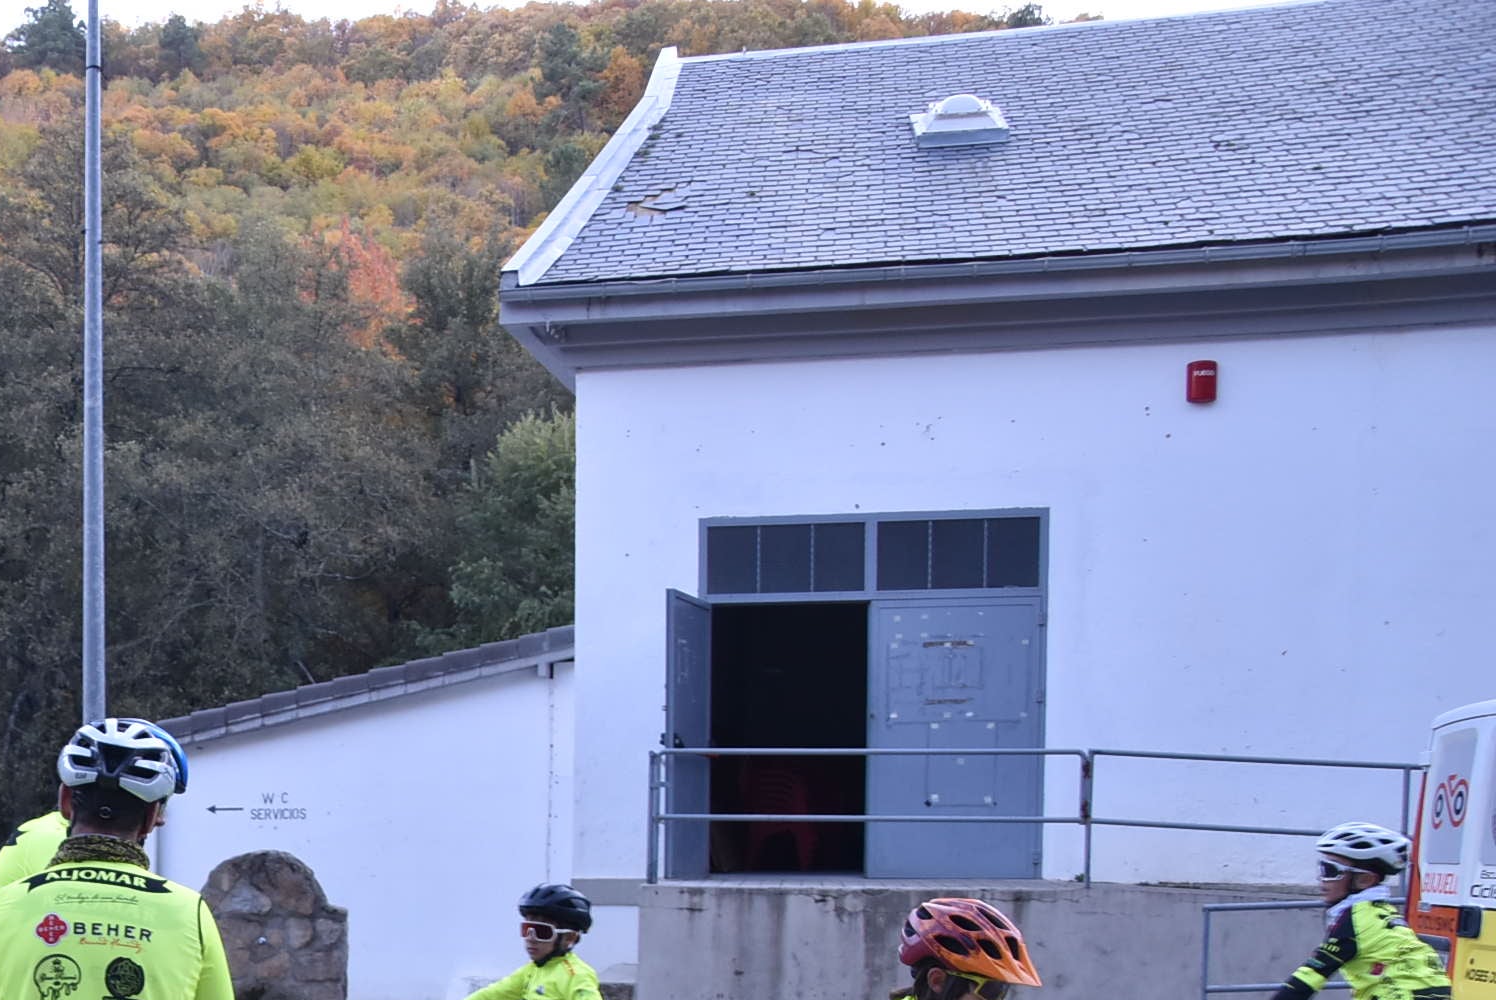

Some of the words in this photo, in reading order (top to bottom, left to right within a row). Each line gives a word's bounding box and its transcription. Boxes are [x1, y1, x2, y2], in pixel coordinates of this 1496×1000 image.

[261, 792, 275, 804] W
[280, 791, 289, 804] C
[249, 807, 308, 821] SERVICIOS
[44, 868, 148, 889] ALJOMAR
[73, 921, 153, 943] BEHER
